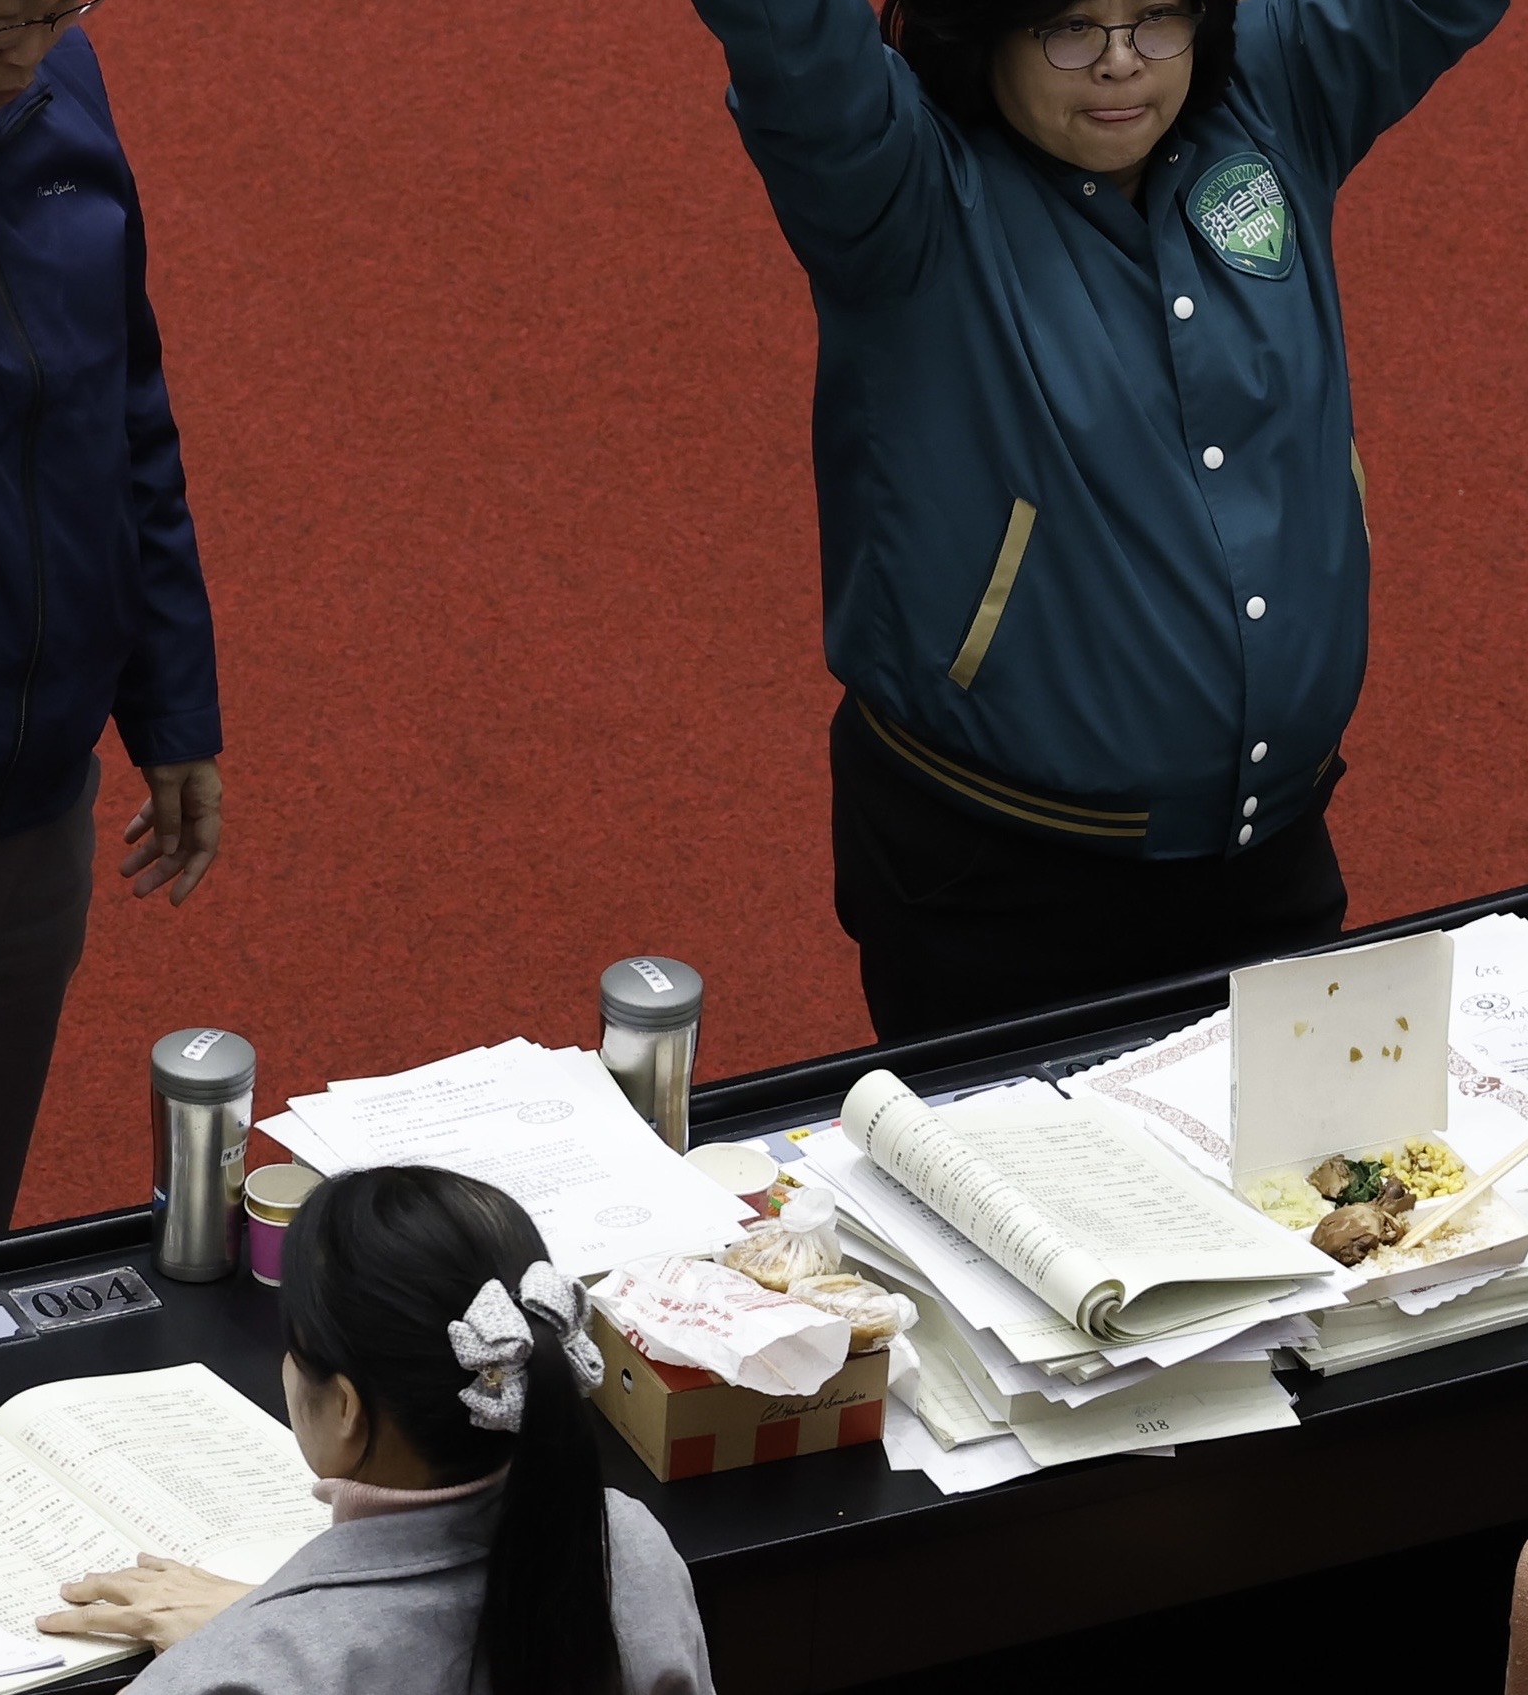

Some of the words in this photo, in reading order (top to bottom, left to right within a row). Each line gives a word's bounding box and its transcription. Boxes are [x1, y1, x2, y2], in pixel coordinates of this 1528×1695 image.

[1196, 180, 1226, 214] TEAM
[1218, 163, 1264, 190] TAIWAN
[1238, 210, 1280, 249] 2024
[31, 1276, 142, 1318] 004
[1136, 1419, 1170, 1434] 318
